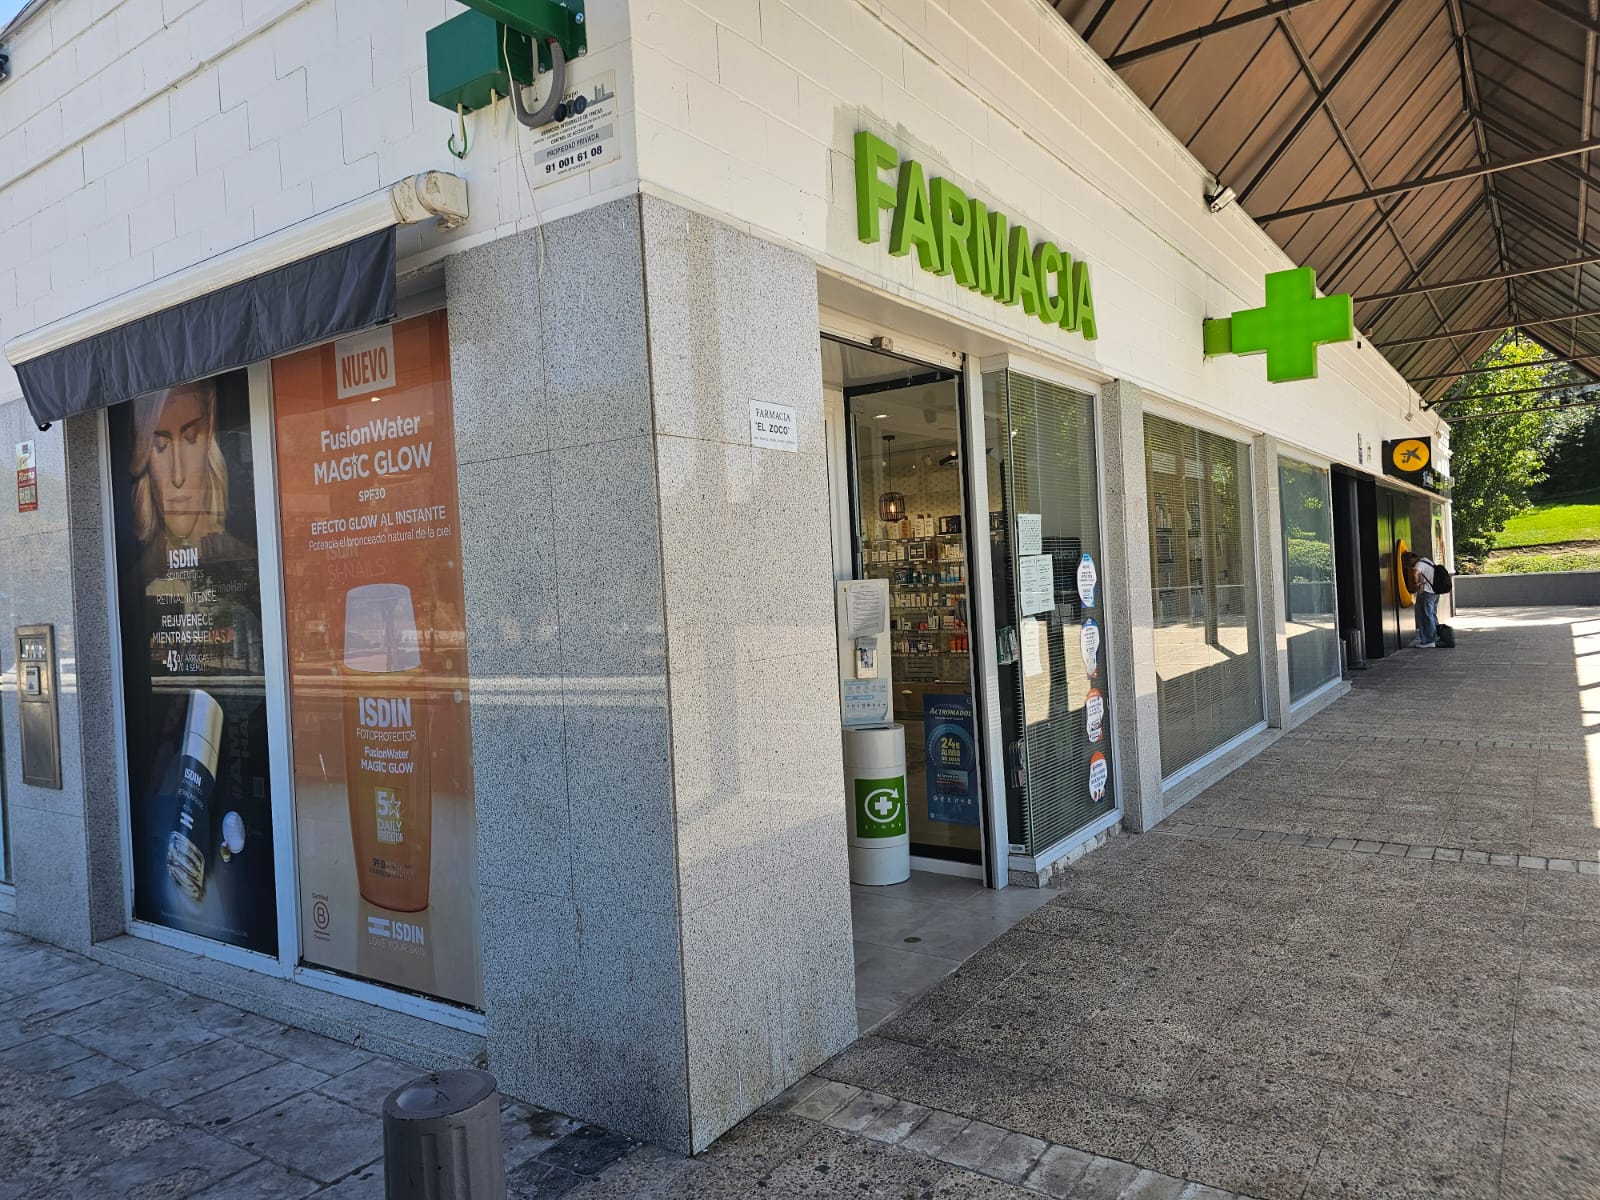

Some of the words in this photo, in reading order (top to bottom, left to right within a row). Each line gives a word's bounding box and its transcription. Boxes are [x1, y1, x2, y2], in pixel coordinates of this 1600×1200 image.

[546, 142, 576, 159] PROPIEDAD
[576, 132, 600, 148] PRIVADA
[545, 163, 556, 174] 91
[558, 156, 574, 169] 001
[577, 150, 588, 163] 61
[590, 145, 603, 157] 08
[854, 130, 1098, 341] FARMACIA
[341, 346, 389, 390] NUEVO
[756, 407, 791, 422] FARMACIA
[320, 415, 421, 453] FusionWater
[313, 452, 370, 486] MAGIC
[374, 441, 433, 476] GLOW
[358, 487, 386, 502] SPF30
[311, 518, 347, 536] EFECTO
[348, 514, 378, 531] GLOW
[380, 512, 394, 527] AL
[395, 505, 446, 525] INSTANTE
[347, 533, 387, 549] bronceado
[387, 529, 414, 543] natural
[415, 527, 426, 540] de
[427, 526, 435, 538] la
[168, 547, 199, 569] ISDIN
[186, 590, 217, 603] INTENSE
[161, 613, 214, 628] REJUVENECE
[152, 630, 192, 645] MIENTRAS
[358, 696, 412, 728] ISDIN
[356, 727, 417, 742] FOTOPROTECTOR
[364, 745, 409, 759] FusionWater
[361, 758, 387, 773] MAGIC
[388, 761, 414, 774] GLOW
[377, 818, 403, 832] DAILY
[392, 920, 425, 945] ISDIN
